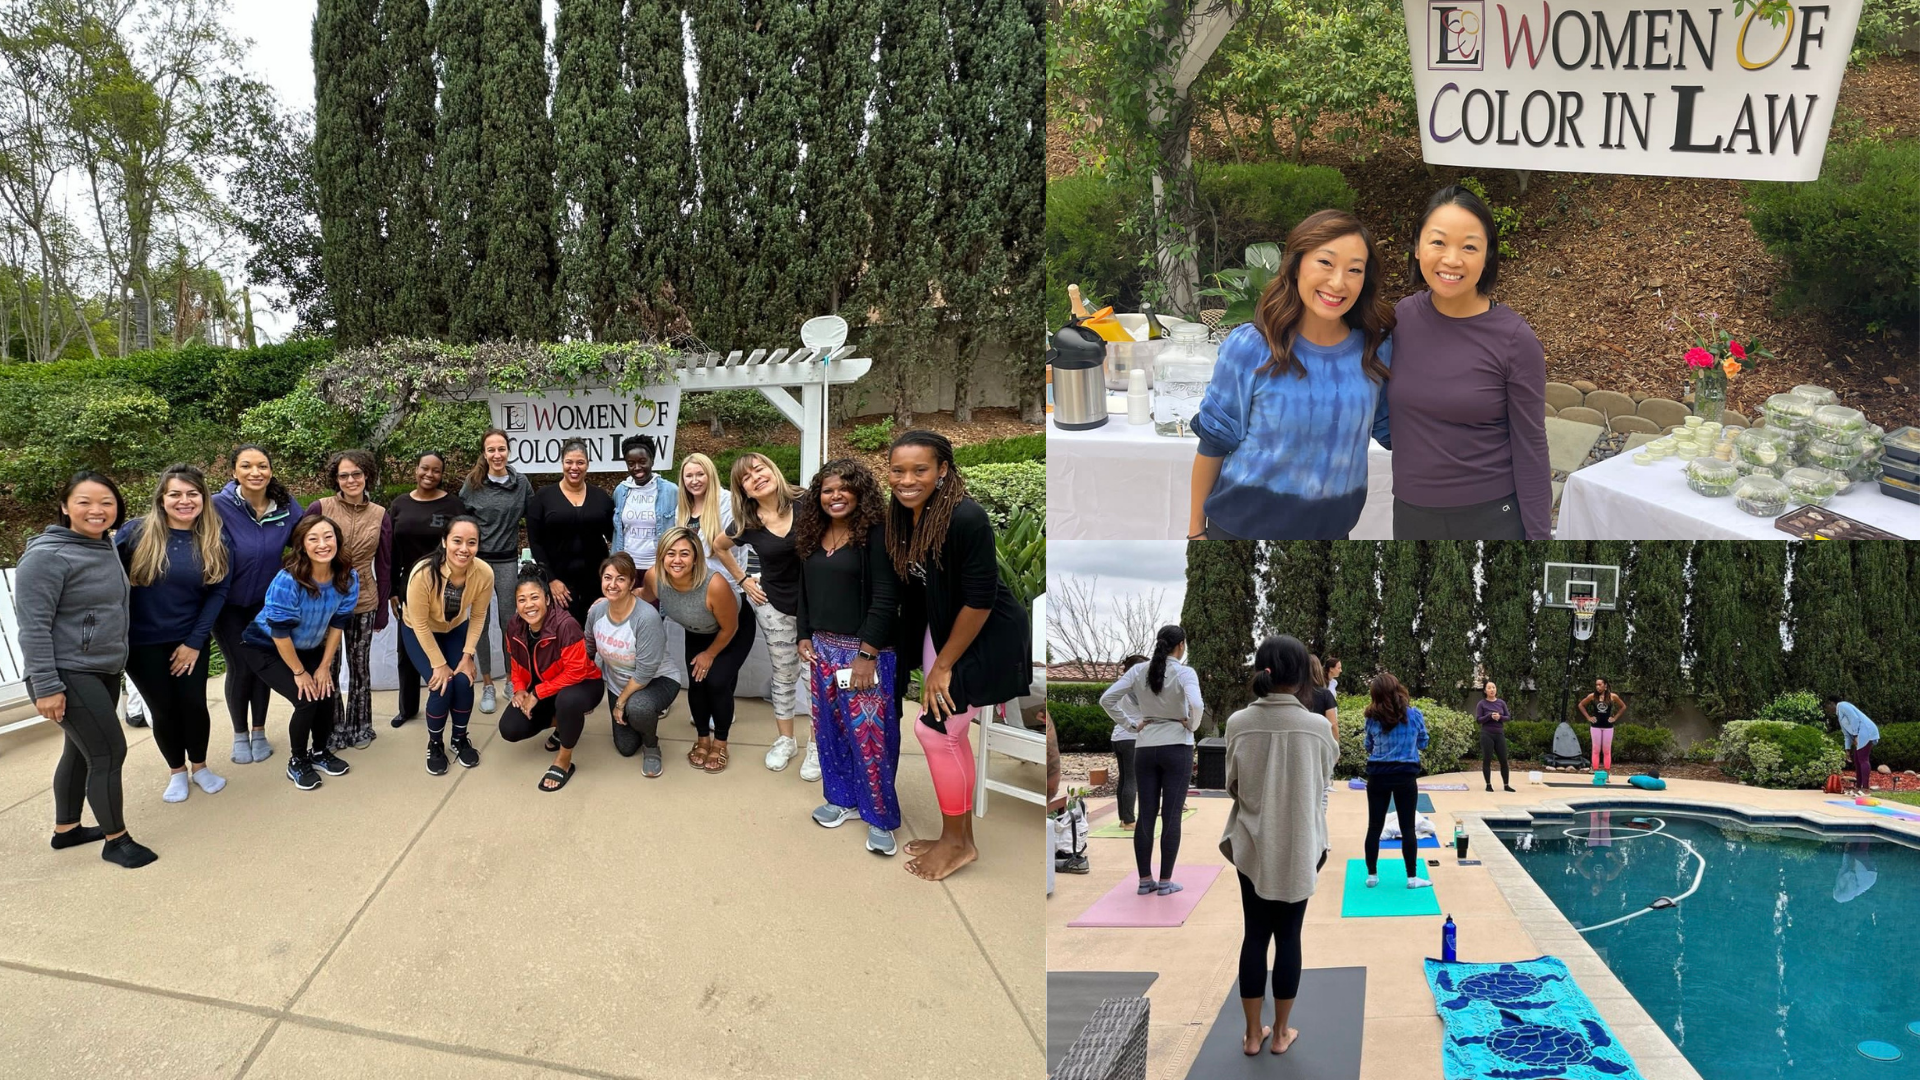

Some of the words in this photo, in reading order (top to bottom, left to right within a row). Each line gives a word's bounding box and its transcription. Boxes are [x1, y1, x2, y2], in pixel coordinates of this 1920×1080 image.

[1496, 1, 1721, 71] WOMEN
[1736, 0, 1830, 71] OF
[1429, 82, 1584, 148] COLOR
[1599, 91, 1656, 151] IN
[1669, 85, 1818, 156] LAW
[532, 402, 628, 431] WOMEN
[634, 400, 669, 428] OF
[507, 437, 572, 464] COLO
[609, 433, 669, 461] LW
[631, 494, 654, 504] MIND
[626, 510, 655, 521] OVER
[626, 527, 657, 537] ATTER
[606, 636, 631, 650] BODY
